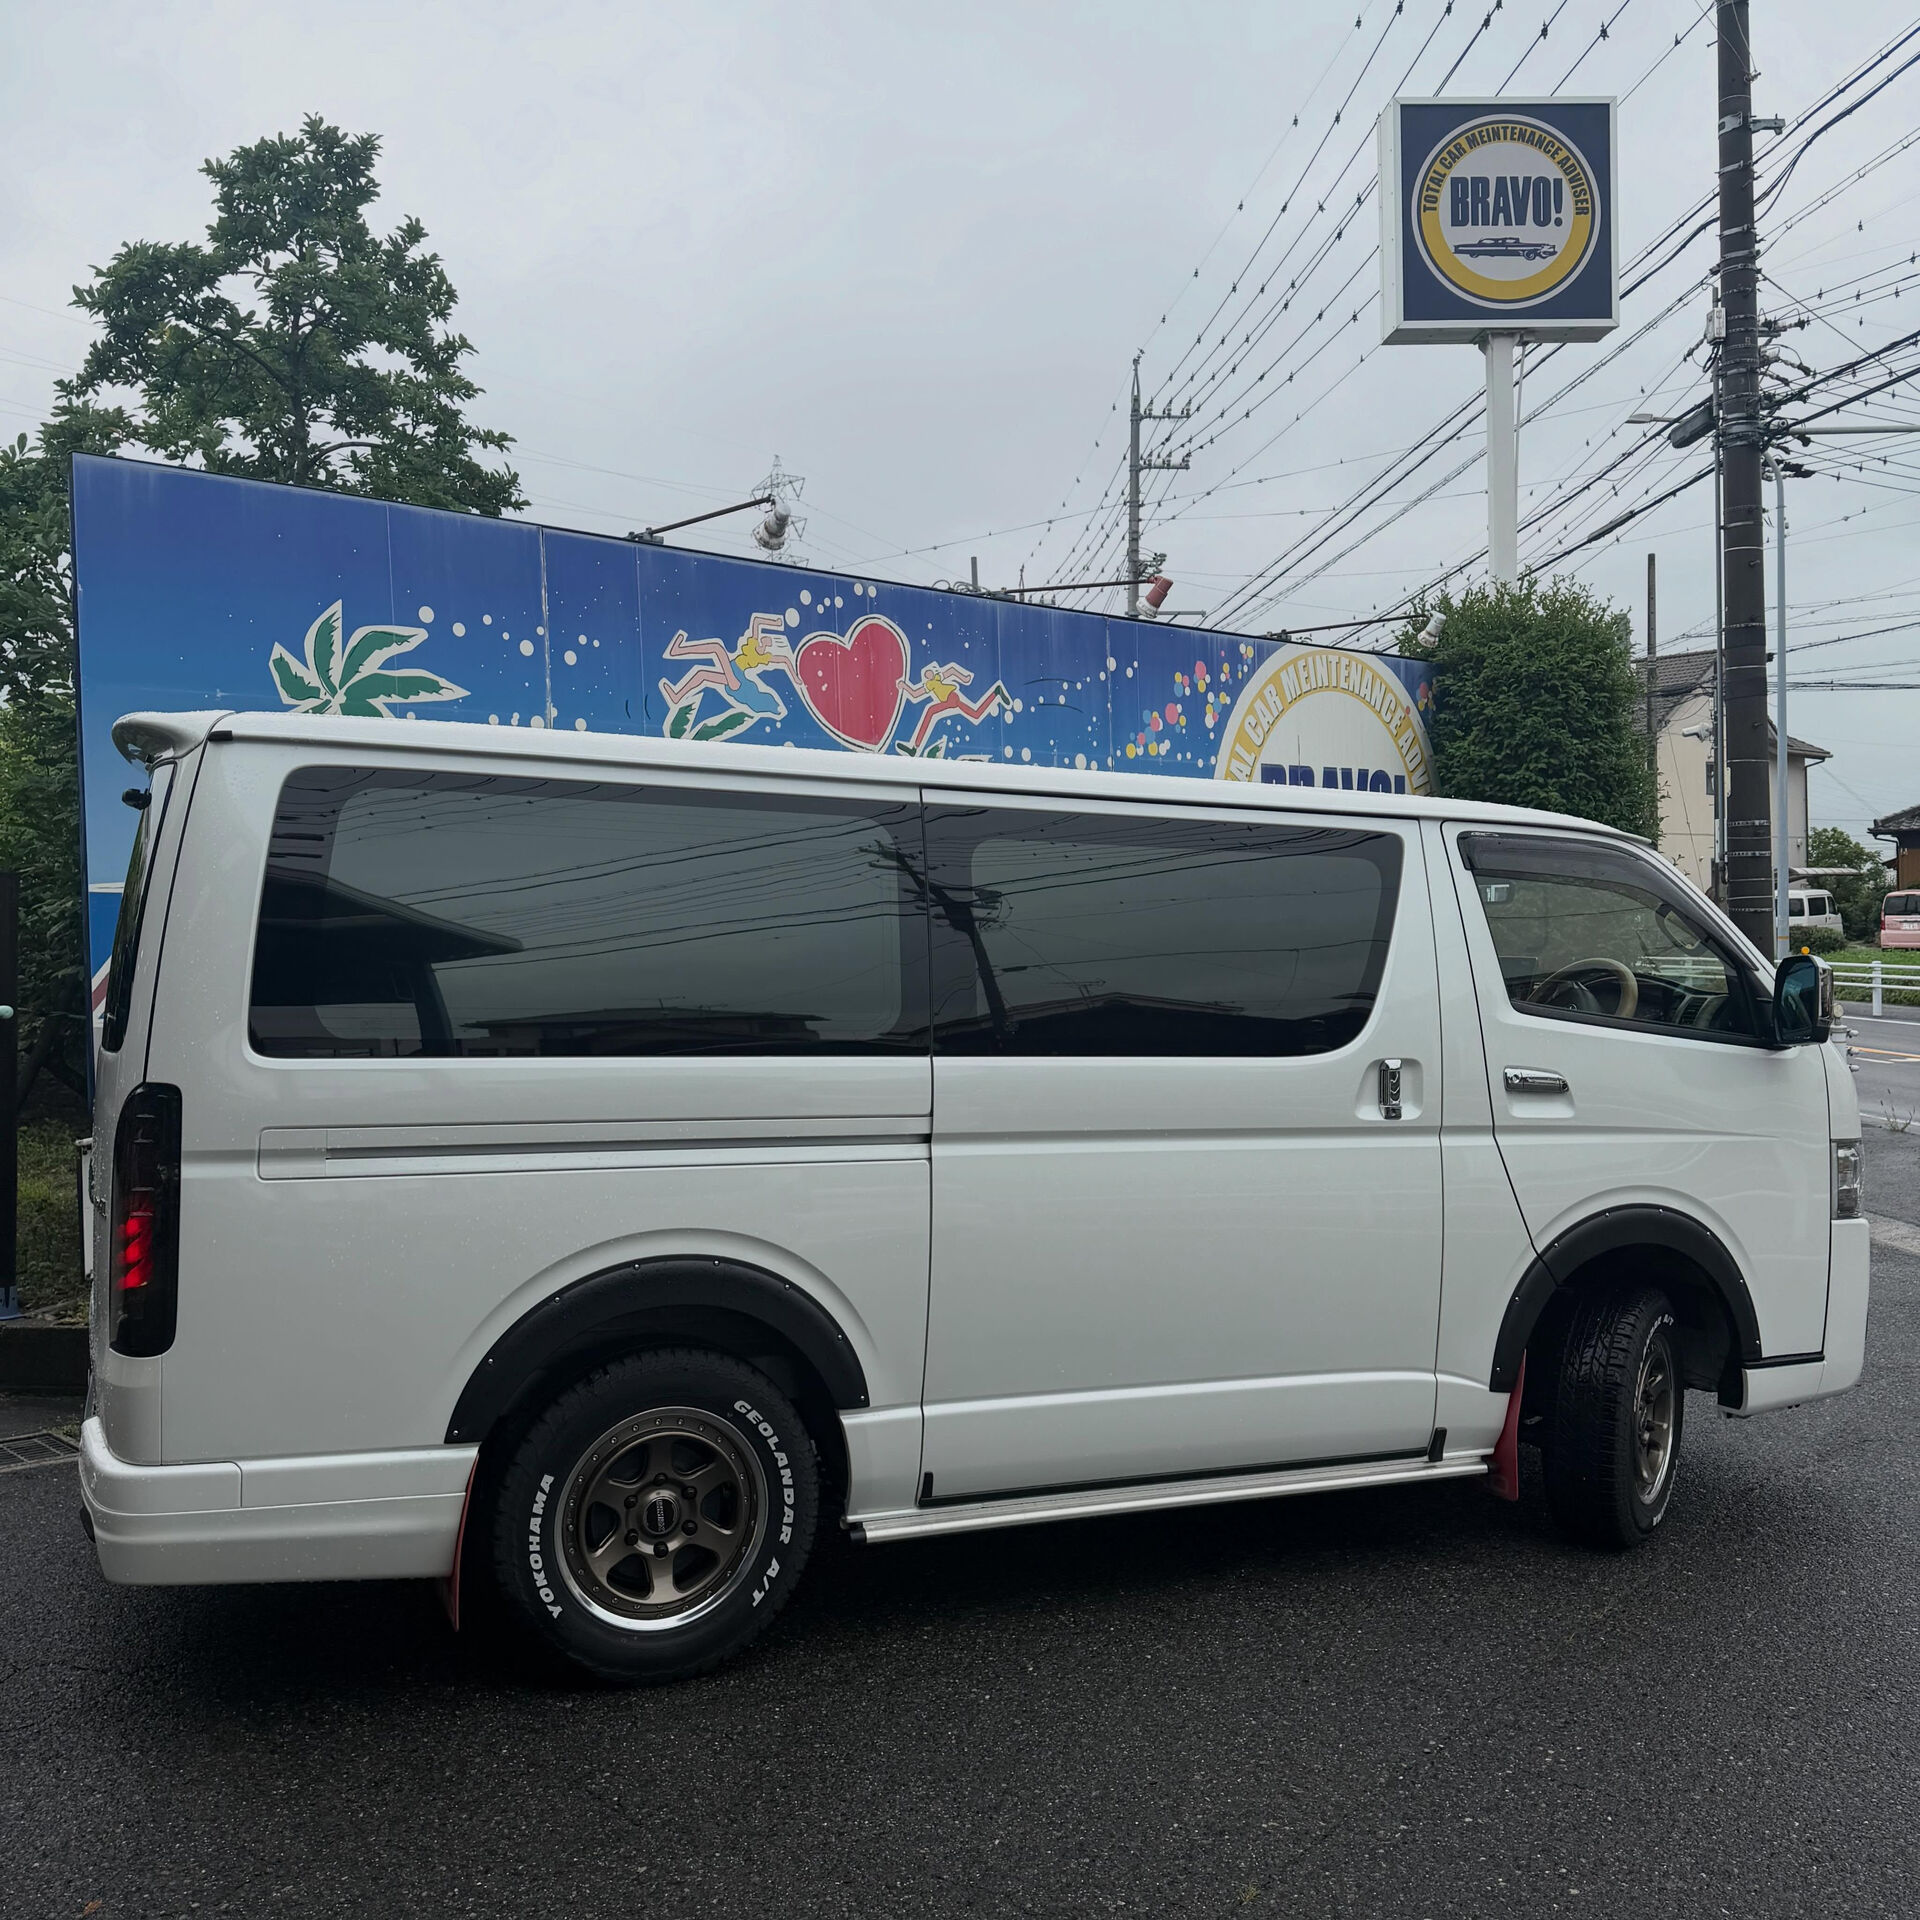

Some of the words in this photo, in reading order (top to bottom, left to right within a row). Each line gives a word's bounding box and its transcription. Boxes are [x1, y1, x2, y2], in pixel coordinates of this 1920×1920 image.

[1423, 169, 1447, 213] TOTAL
[1439, 142, 1467, 170] CAR
[1464, 126, 1563, 160] MEINTENANCE
[1557, 155, 1590, 216] ADVISER
[1450, 176, 1563, 227] BRAVO!
[1244, 683, 1284, 747] CAR
[1280, 655, 1406, 737] MEINTENANCE
[733, 1400, 795, 1545] GEOLANDAR
[528, 1474, 563, 1619] YOKOHAMA
[752, 1556, 781, 1608] A/T
